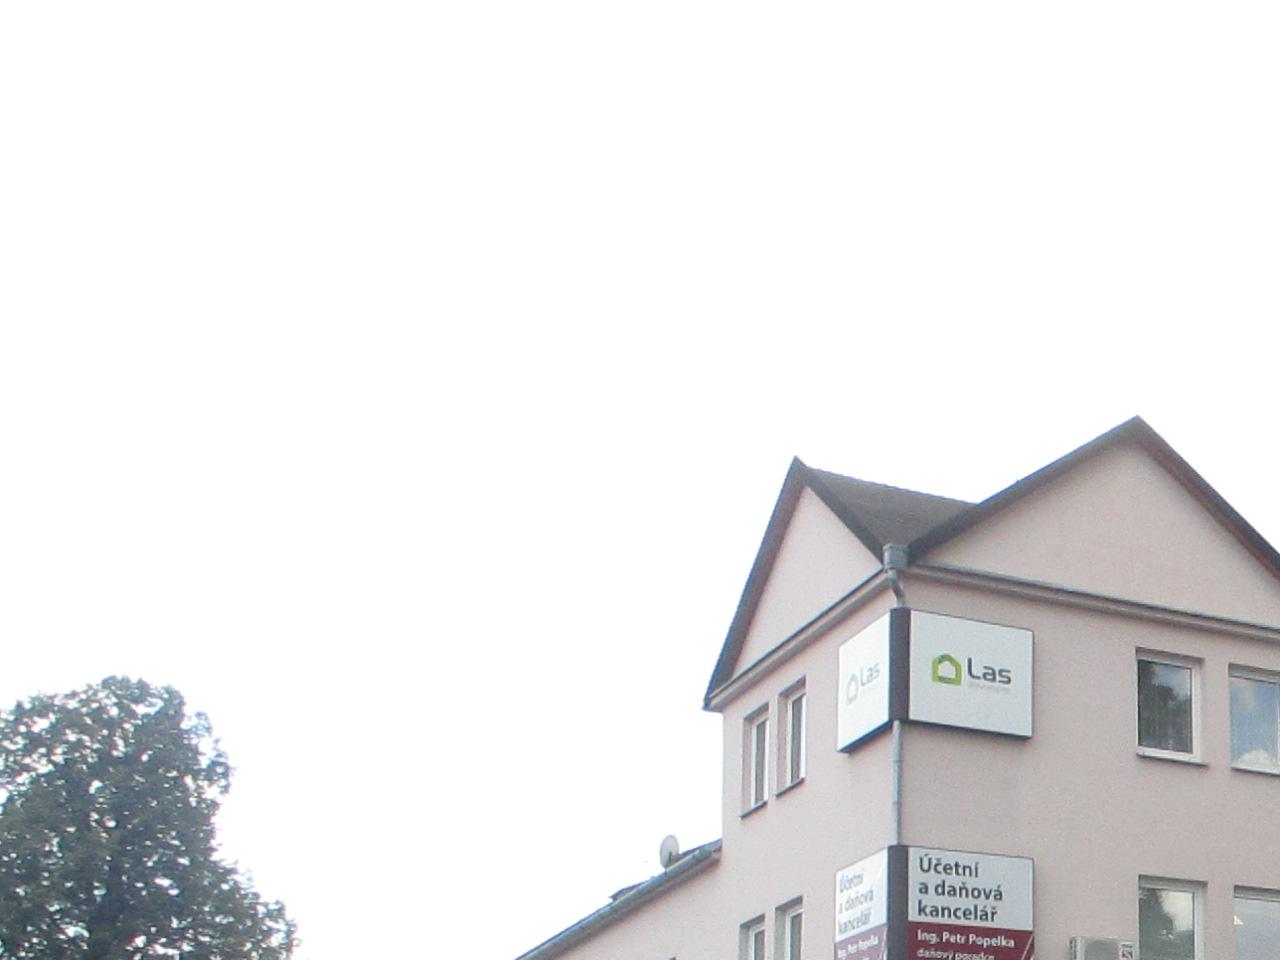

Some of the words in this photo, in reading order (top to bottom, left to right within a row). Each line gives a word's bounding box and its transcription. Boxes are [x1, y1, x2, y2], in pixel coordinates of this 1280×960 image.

[967, 657, 1012, 685] Las
[919, 853, 980, 878] Účetní
[918, 882, 929, 895] a
[934, 878, 1003, 902] daňová
[918, 899, 998, 922] kancelář
[917, 929, 940, 945] Ing.
[942, 932, 967, 945] Petr
[969, 934, 1015, 949] Popelka
